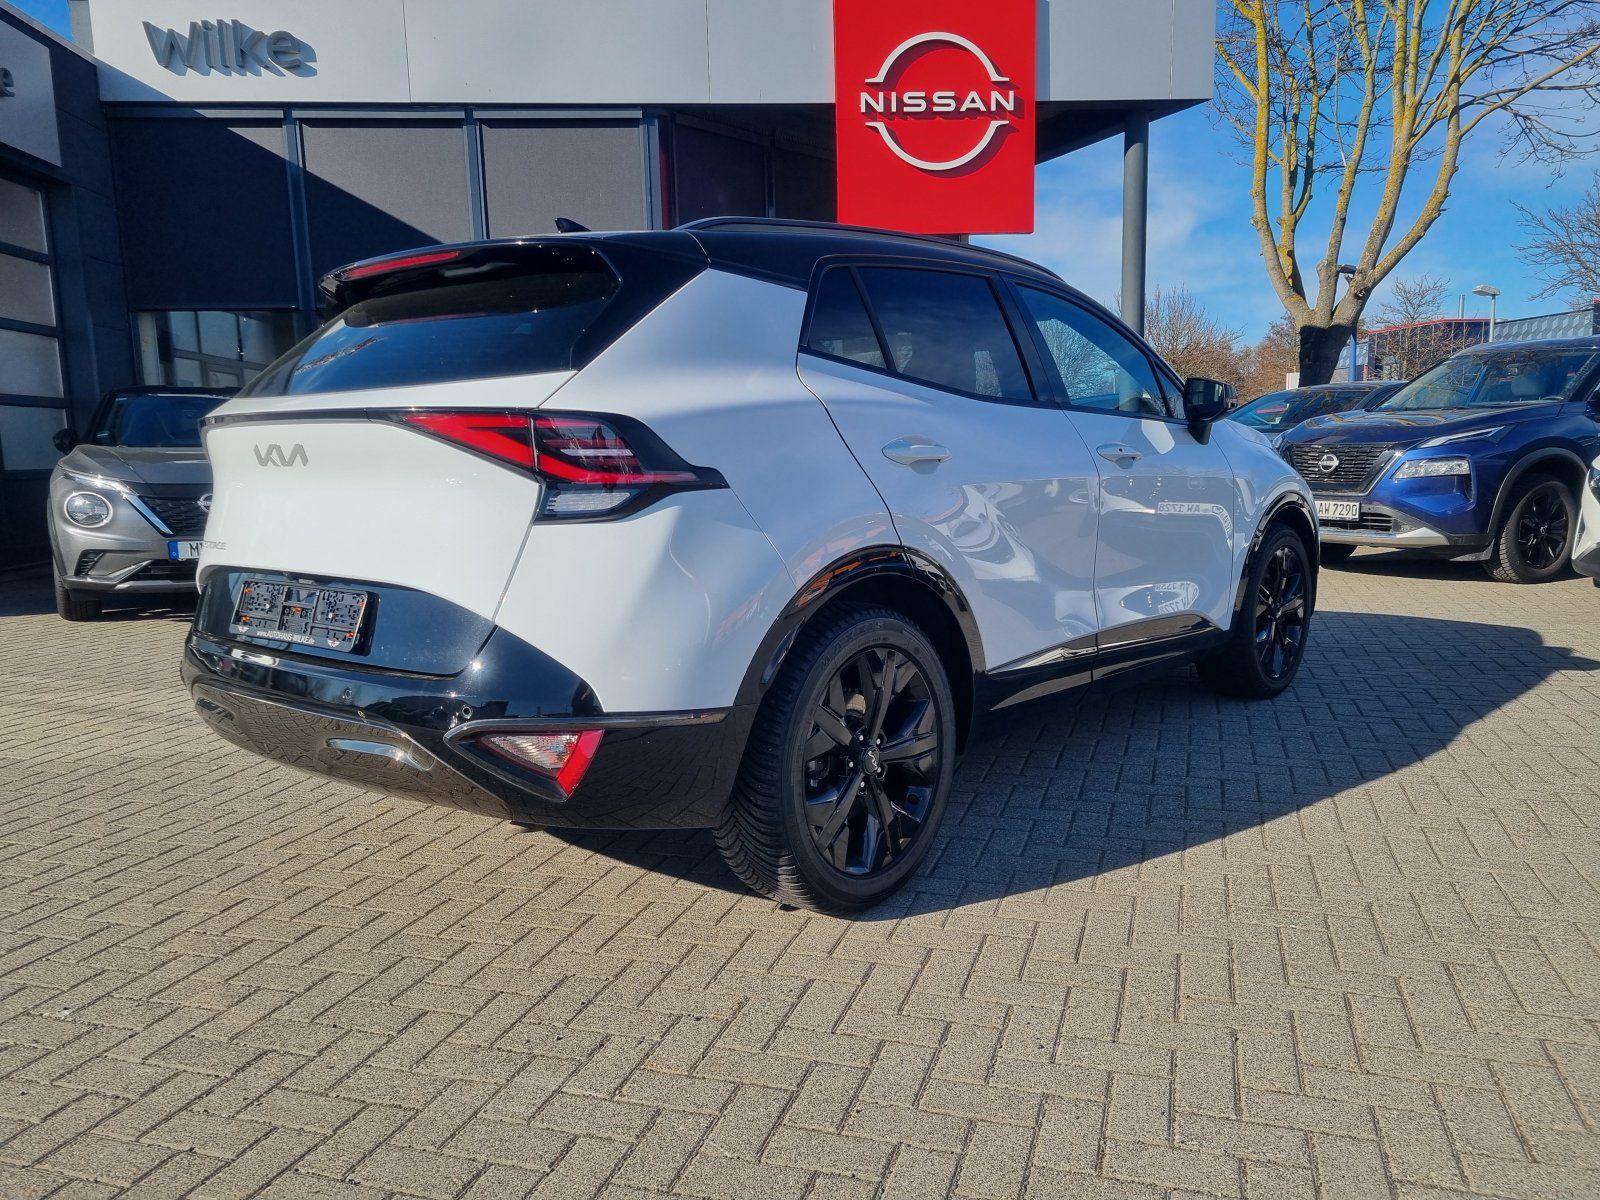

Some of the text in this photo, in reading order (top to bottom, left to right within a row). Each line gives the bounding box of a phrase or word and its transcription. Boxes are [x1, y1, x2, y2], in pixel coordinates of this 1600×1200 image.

[142, 19, 303, 70] Wilke
[860, 90, 1015, 113] NISSAN
[1332, 503, 1358, 517] 7290
